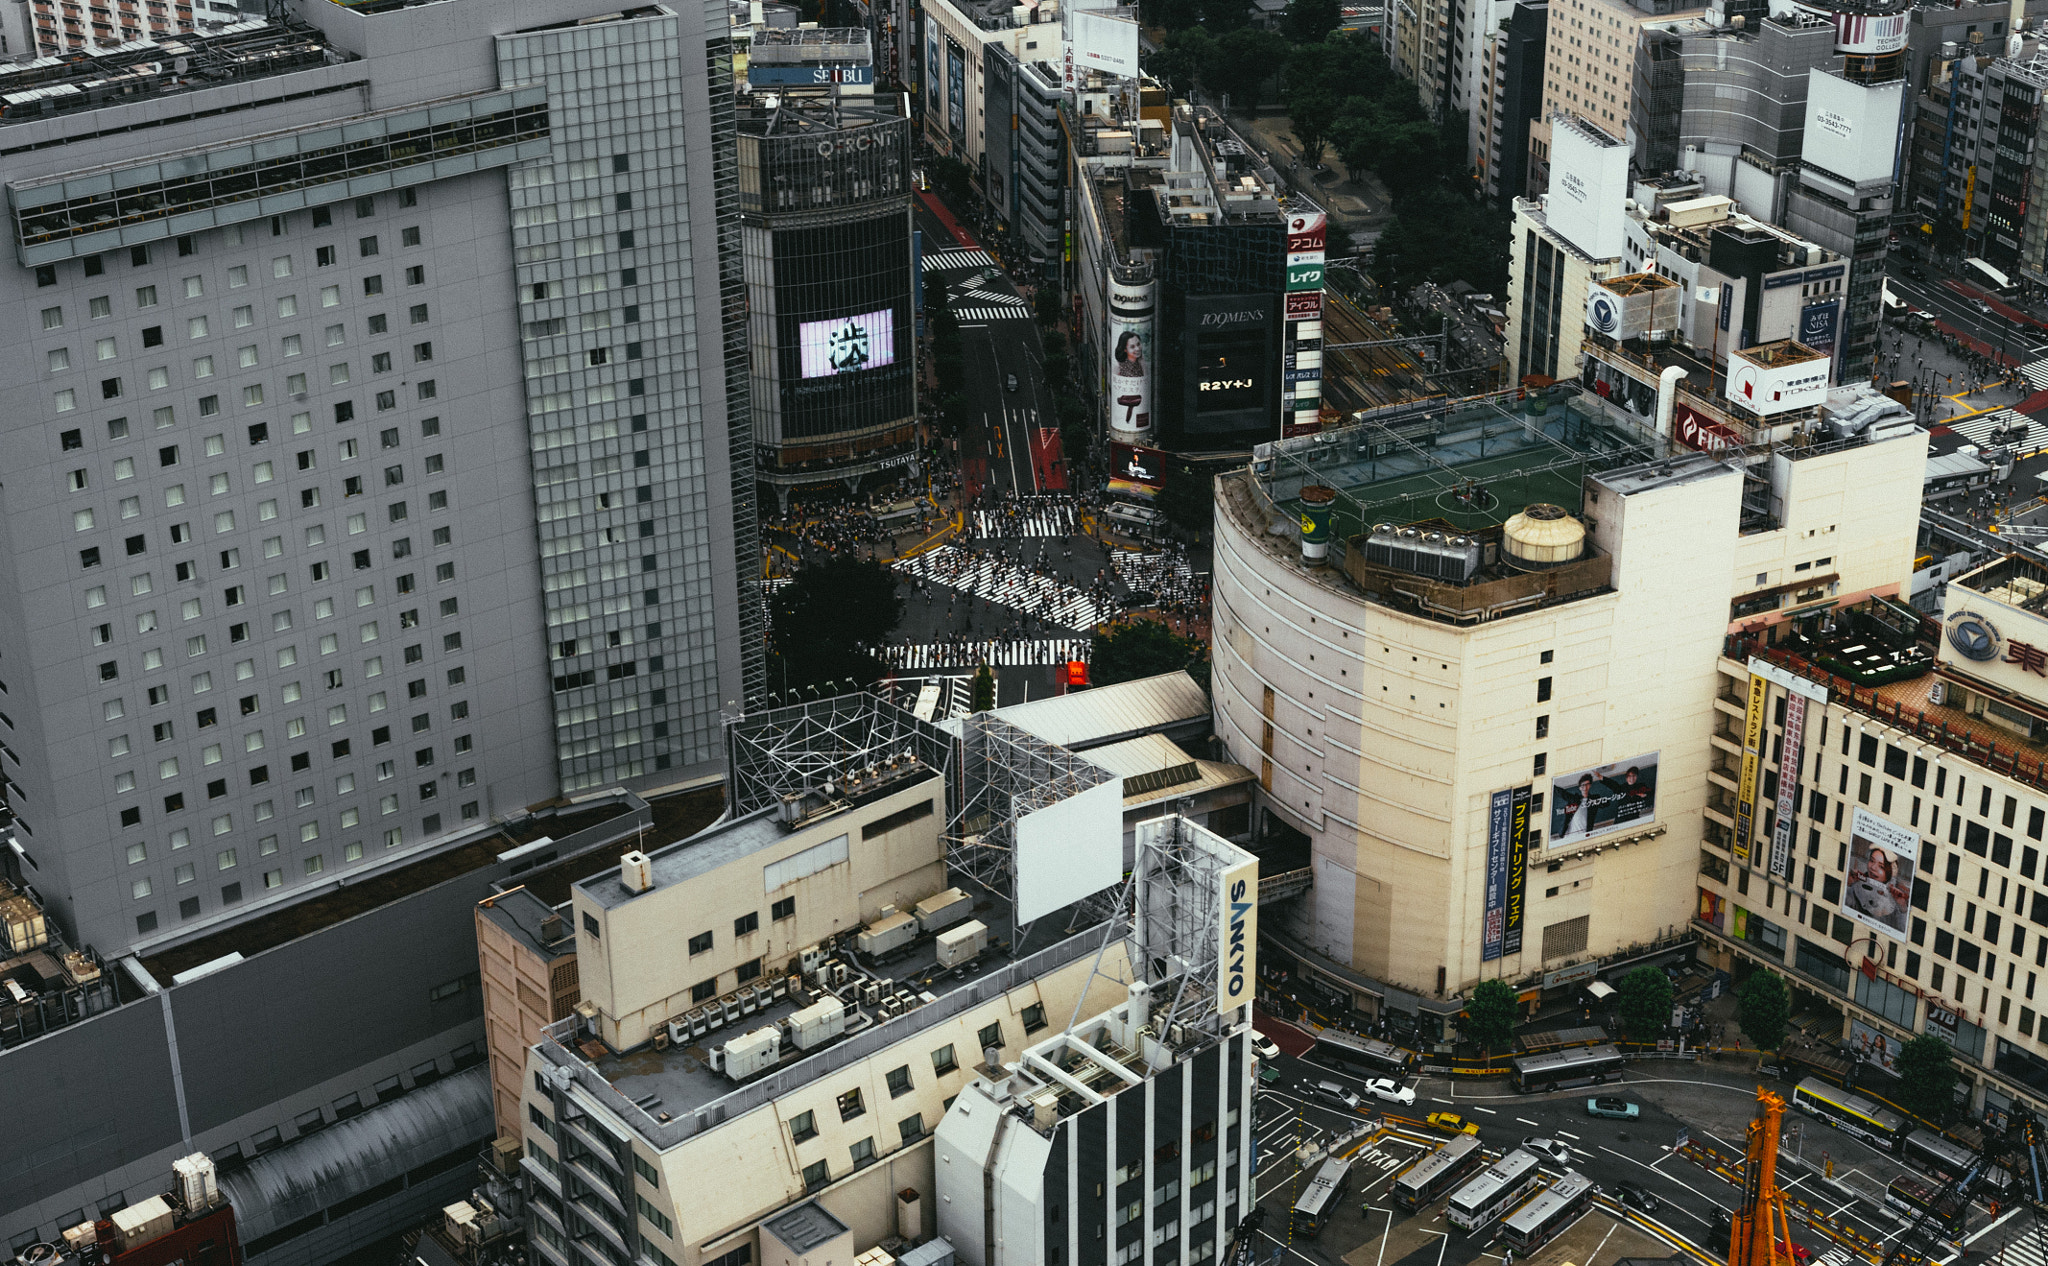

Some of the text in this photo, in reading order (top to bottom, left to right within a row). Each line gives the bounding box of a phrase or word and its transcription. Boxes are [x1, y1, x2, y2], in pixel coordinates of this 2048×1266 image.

[814, 69, 862, 83] SEIBU
[1291, 238, 1323, 249] アコム
[1290, 271, 1321, 283] レイク
[1289, 301, 1319, 311] アイフル
[1200, 379, 1252, 391] R2Y+J
[1783, 382, 1827, 395] TOKYU
[879, 453, 916, 470] TSUTAYA
[1748, 678, 1762, 748] 東急レストラン街
[1511, 802, 1527, 890] ブライトリング
[1509, 894, 1520, 927] フェア
[1228, 879, 1253, 997] SANKYO
[1929, 1008, 1956, 1026] JTB
